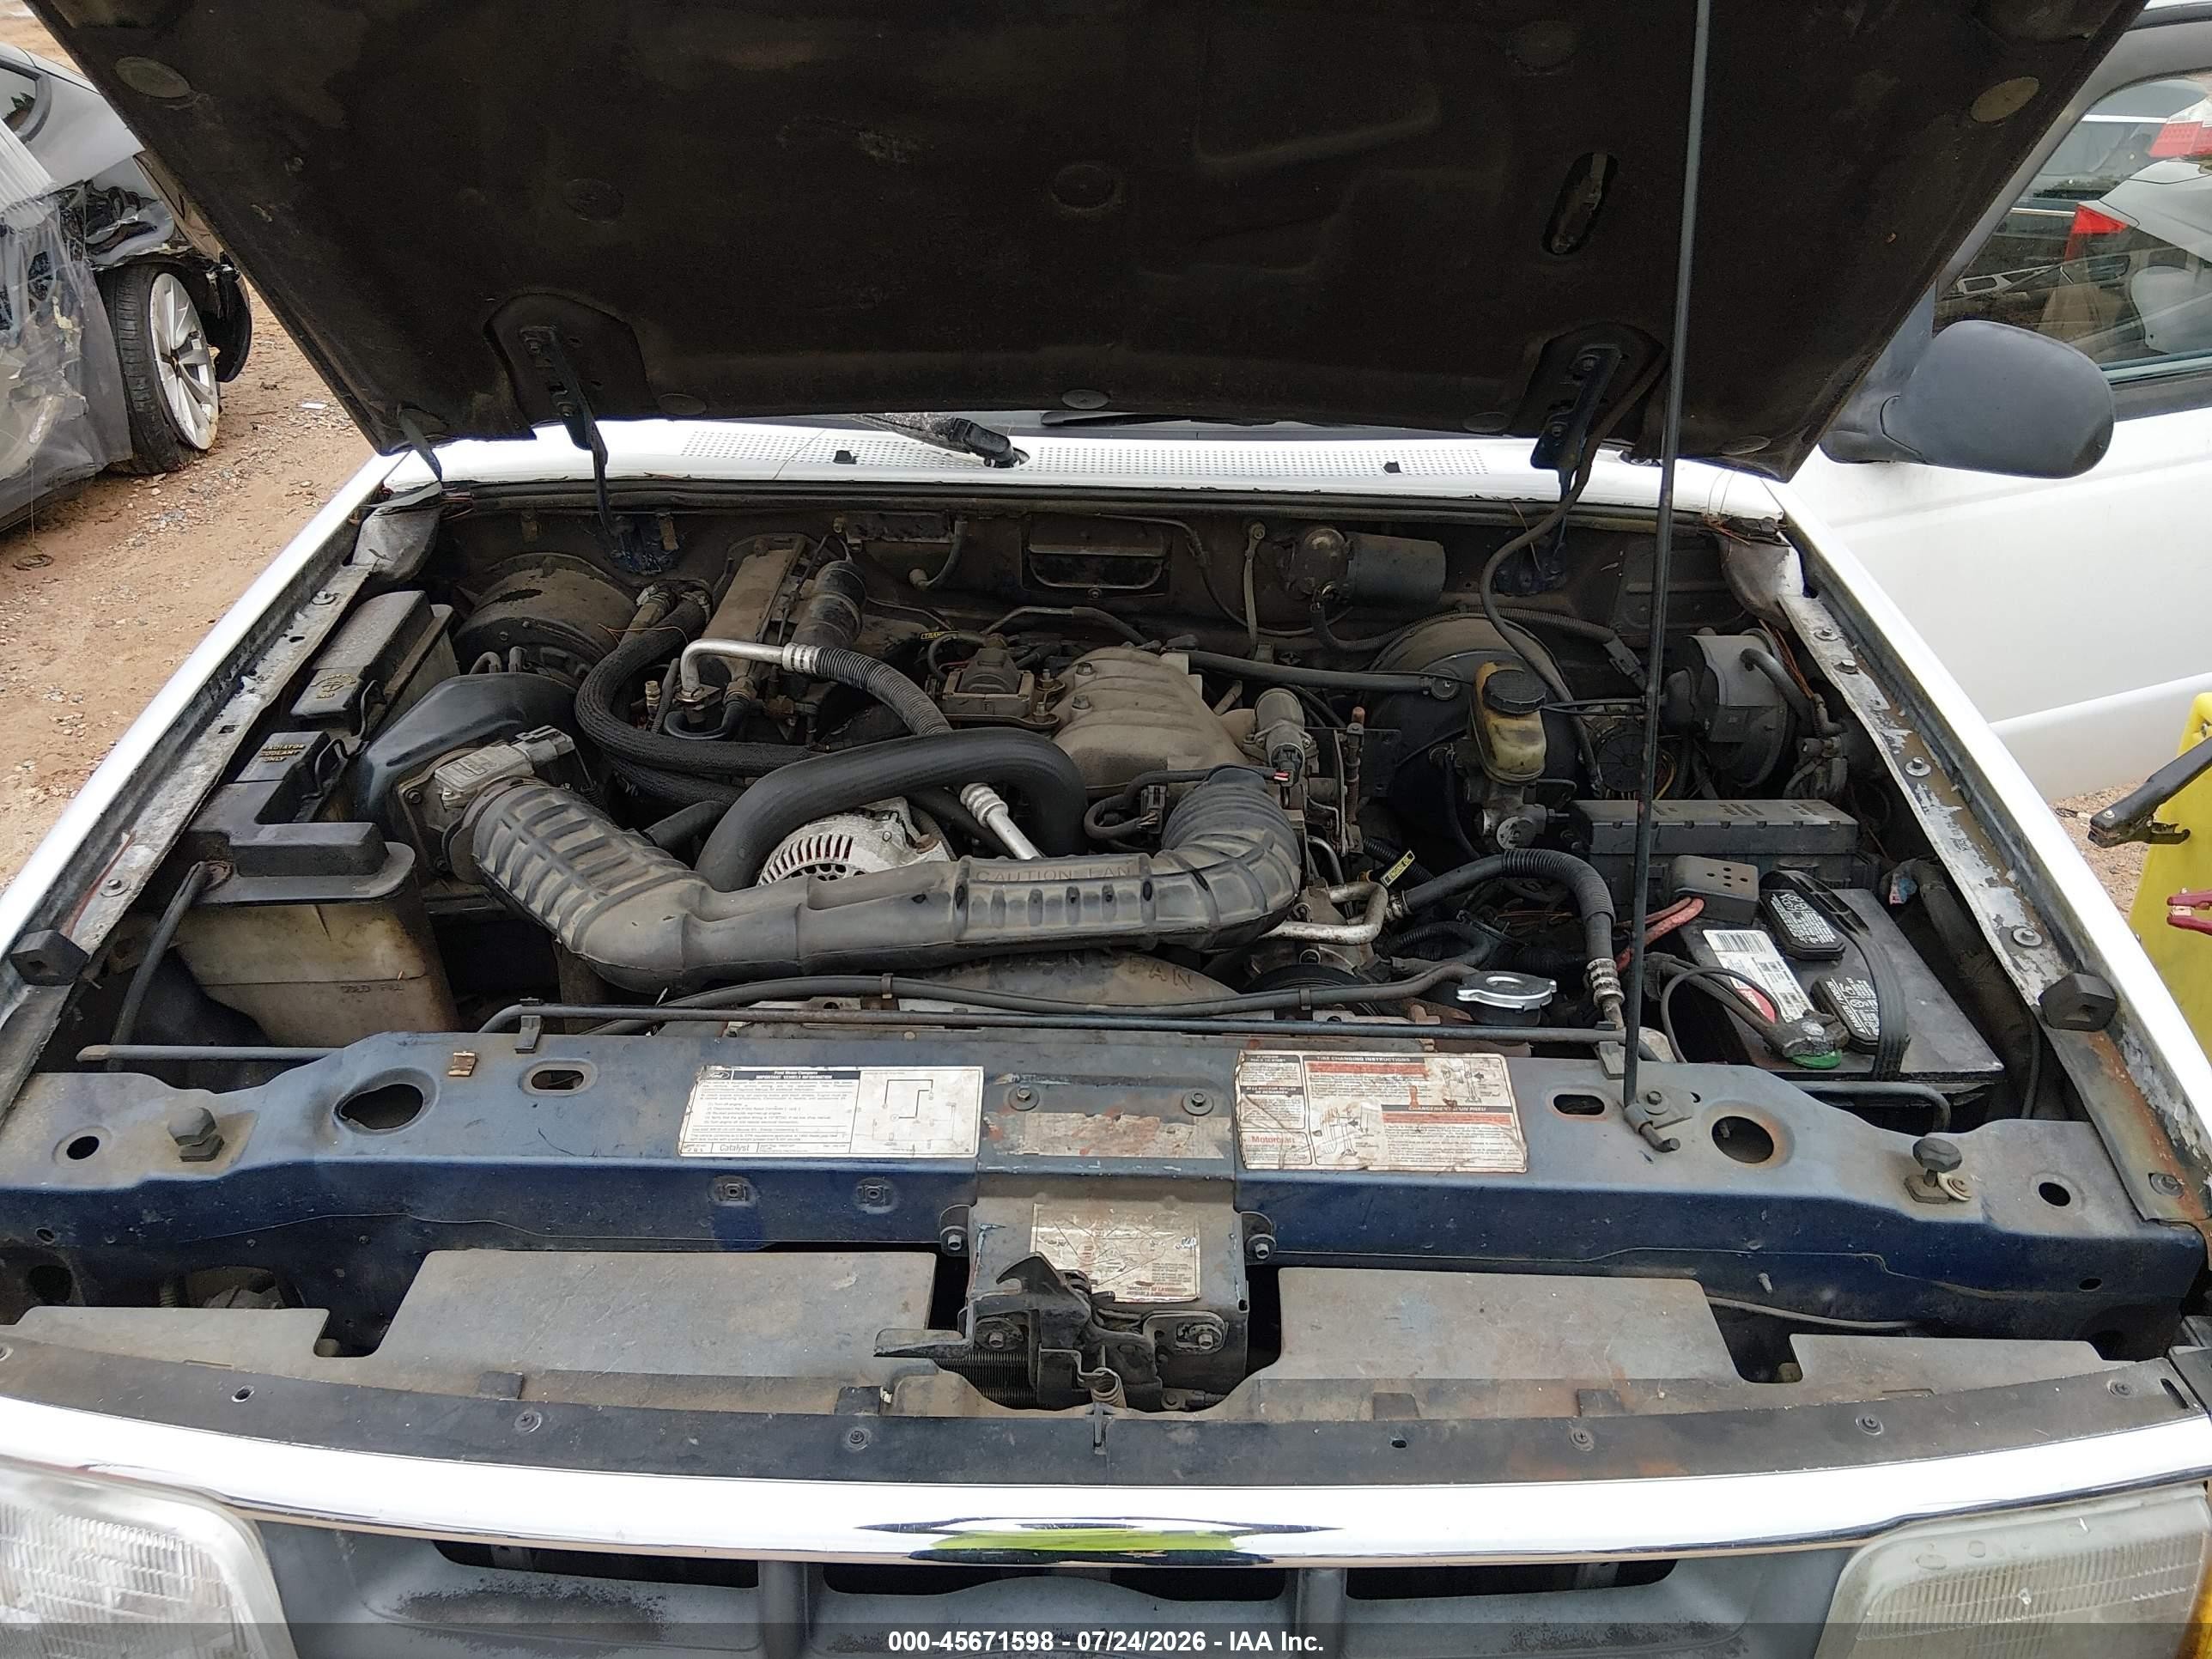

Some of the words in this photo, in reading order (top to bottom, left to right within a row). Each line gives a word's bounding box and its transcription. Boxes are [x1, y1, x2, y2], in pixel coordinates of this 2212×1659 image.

[975, 867, 1073, 882] CAUTION
[1128, 955, 1194, 991] FAN
[720, 1140, 750, 1152] Catalyst
